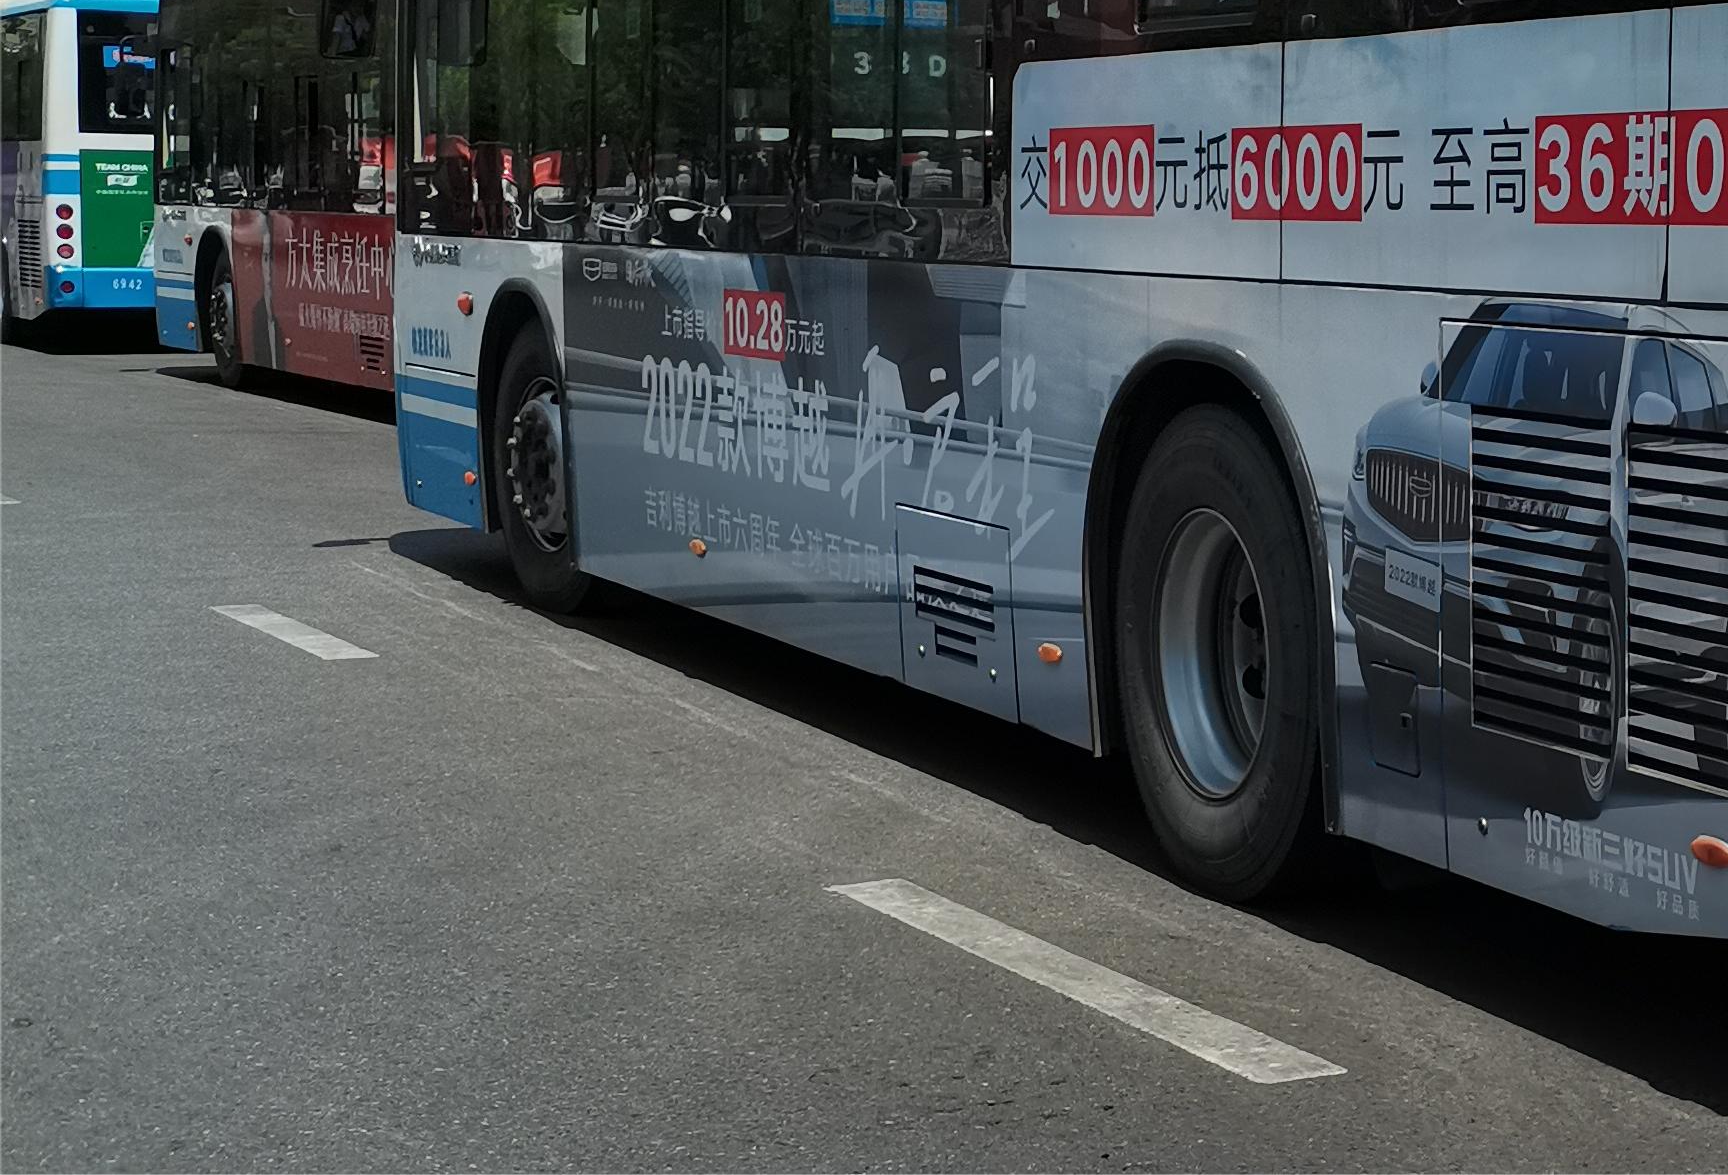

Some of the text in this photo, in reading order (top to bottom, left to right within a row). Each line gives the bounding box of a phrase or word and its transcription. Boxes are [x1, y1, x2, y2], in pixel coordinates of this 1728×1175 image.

[1019, 127, 1406, 215] 交1000元抵6000元
[113, 278, 142, 291] 6942
[641, 353, 831, 493] 2022款博越
[644, 485, 782, 559] 吉利博越上市六周年
[1523, 806, 1699, 896] 10万级新三好SUV
